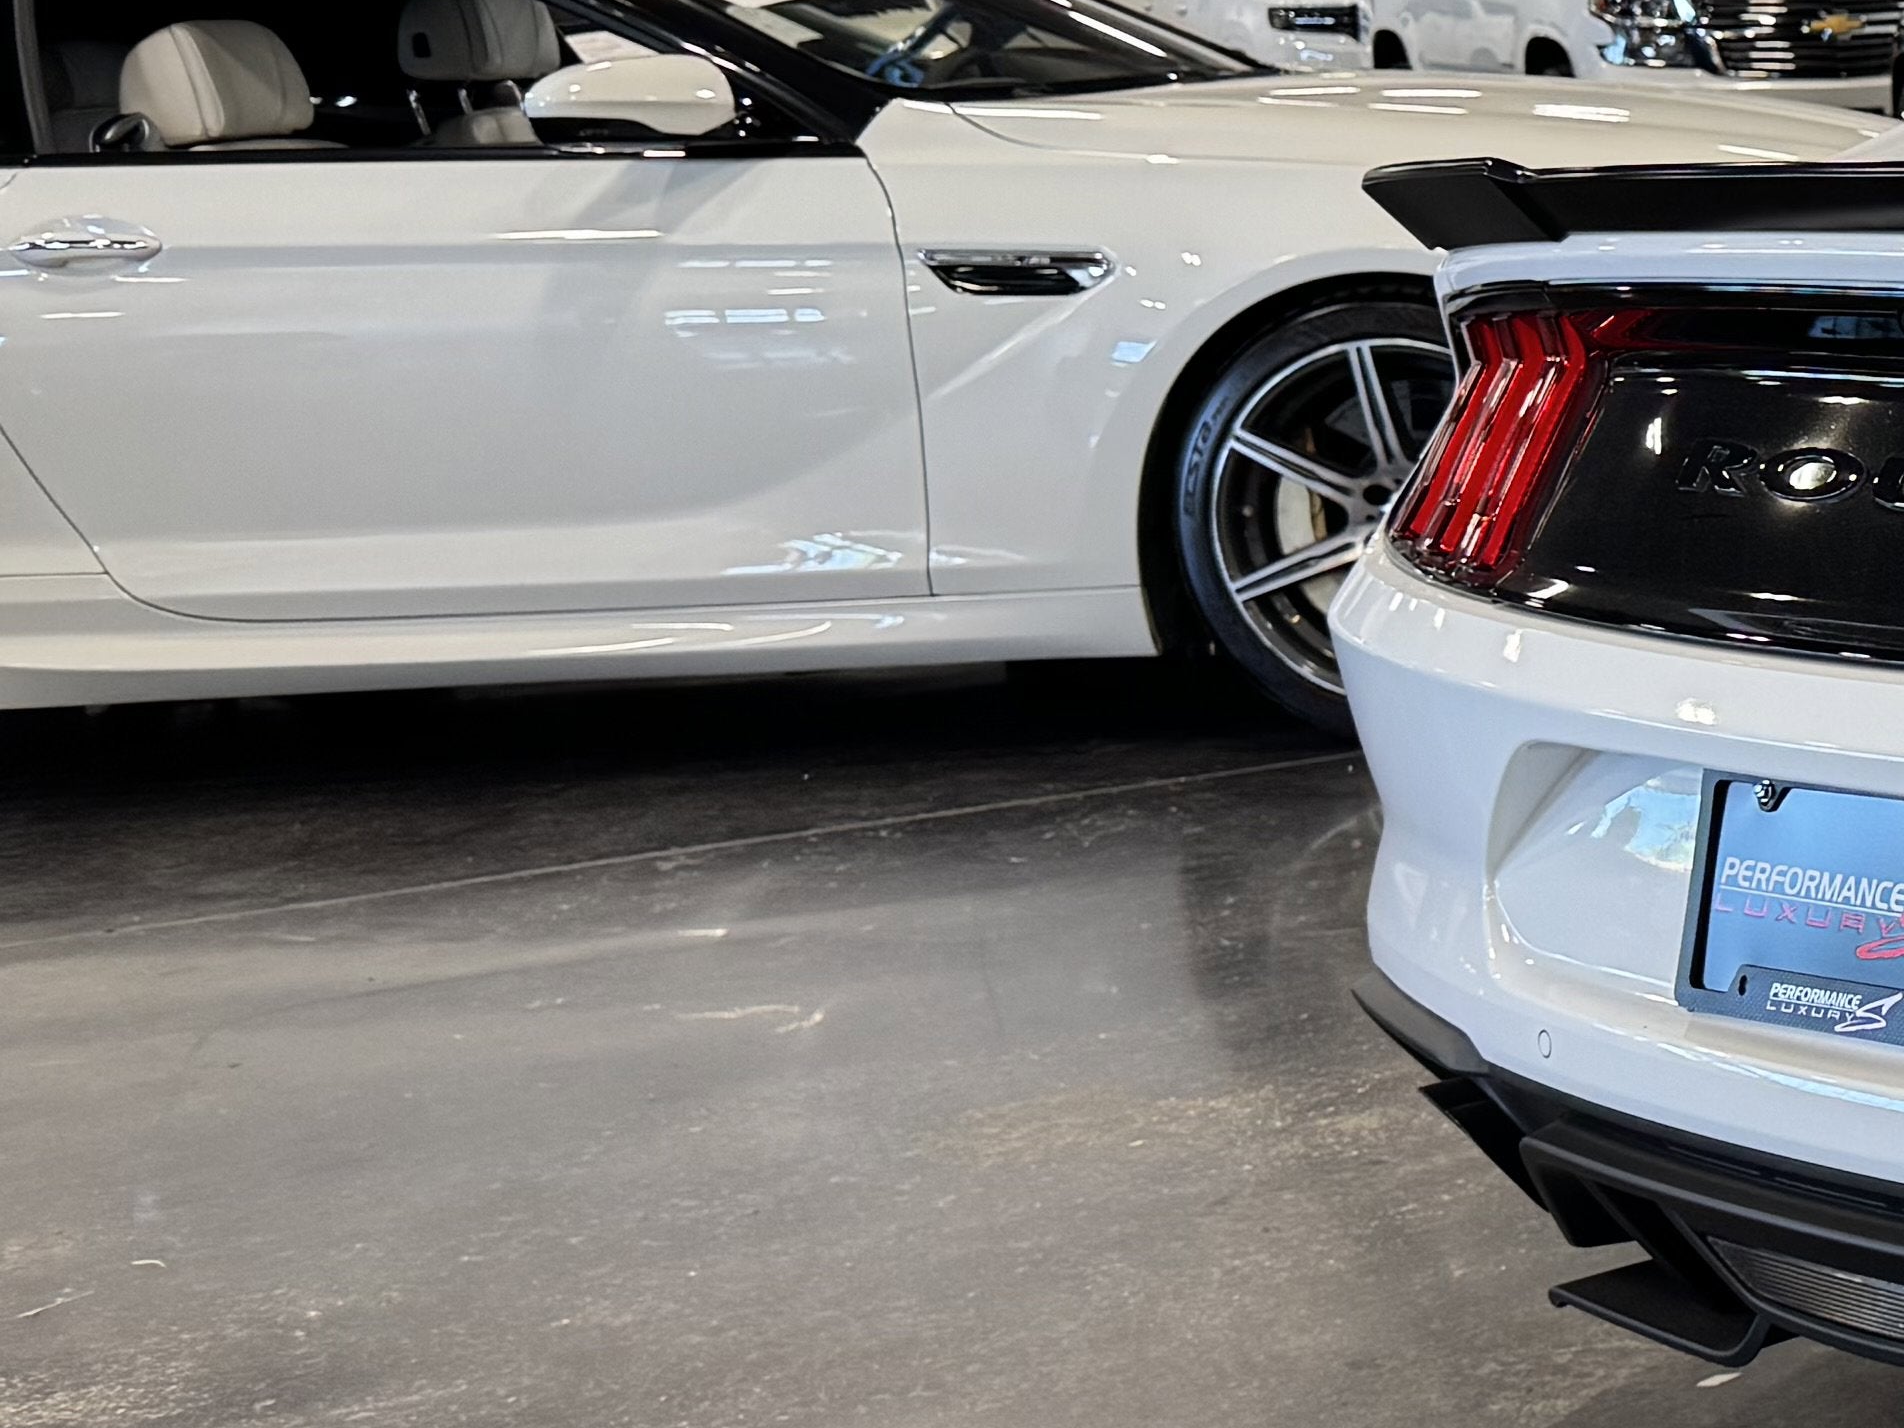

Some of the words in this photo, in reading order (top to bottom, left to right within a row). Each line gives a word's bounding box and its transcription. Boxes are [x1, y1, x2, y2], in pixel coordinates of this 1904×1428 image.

[1714, 890, 1900, 939] LUXURY
[1769, 982, 1863, 1010] PERFORMANCE
[1766, 1000, 1854, 1023] LUXURY
